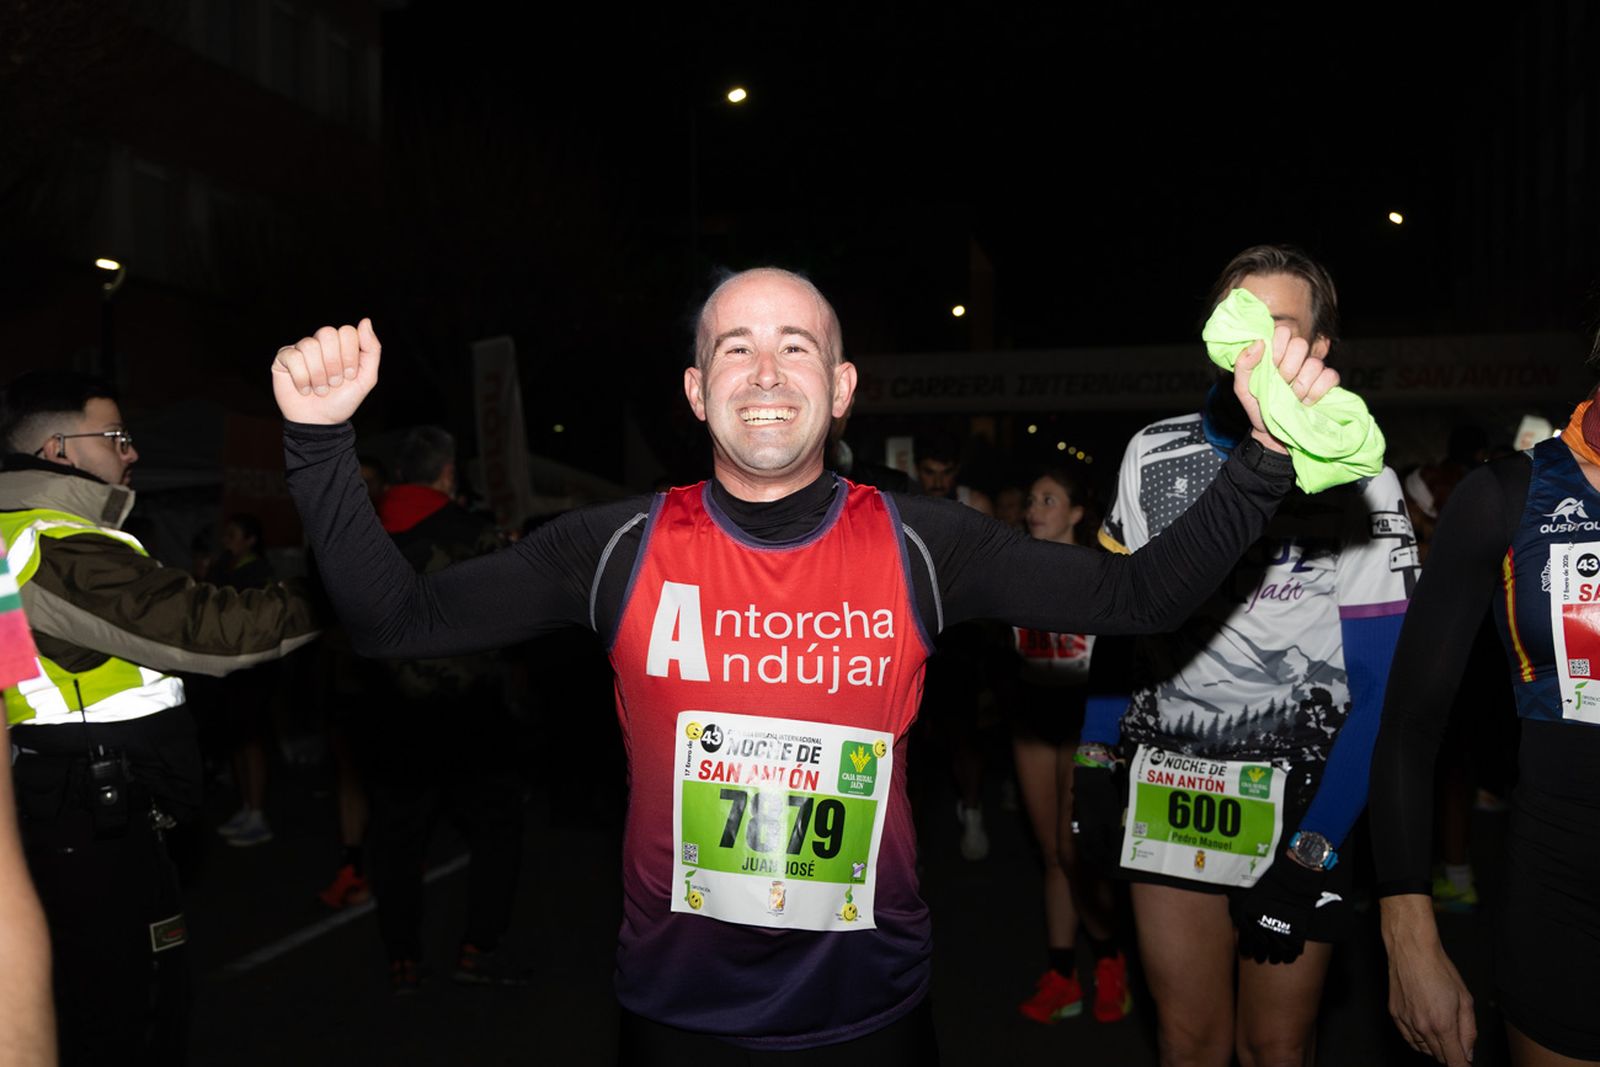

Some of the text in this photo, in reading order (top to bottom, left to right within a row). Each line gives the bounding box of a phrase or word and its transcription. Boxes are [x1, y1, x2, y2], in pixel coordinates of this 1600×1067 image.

[890, 375, 1006, 399] CARRERA
[1394, 364, 1456, 389] SAN
[1577, 558, 1599, 571] 43
[700, 729, 722, 746] 43
[778, 734, 822, 745] INTERNACIONAL
[726, 737, 823, 765] NOCHE DE
[697, 759, 820, 791] SAN ANTÓN
[1164, 756, 1208, 775] NOCHE
[1208, 763, 1228, 777] DE
[1146, 769, 1226, 794] SAN ANTÓN
[719, 788, 846, 860] 7879
[1168, 791, 1242, 838] 600
[1171, 831, 1233, 851] Pedro Manuel
[742, 856, 815, 878] JUAN JOSÉ
